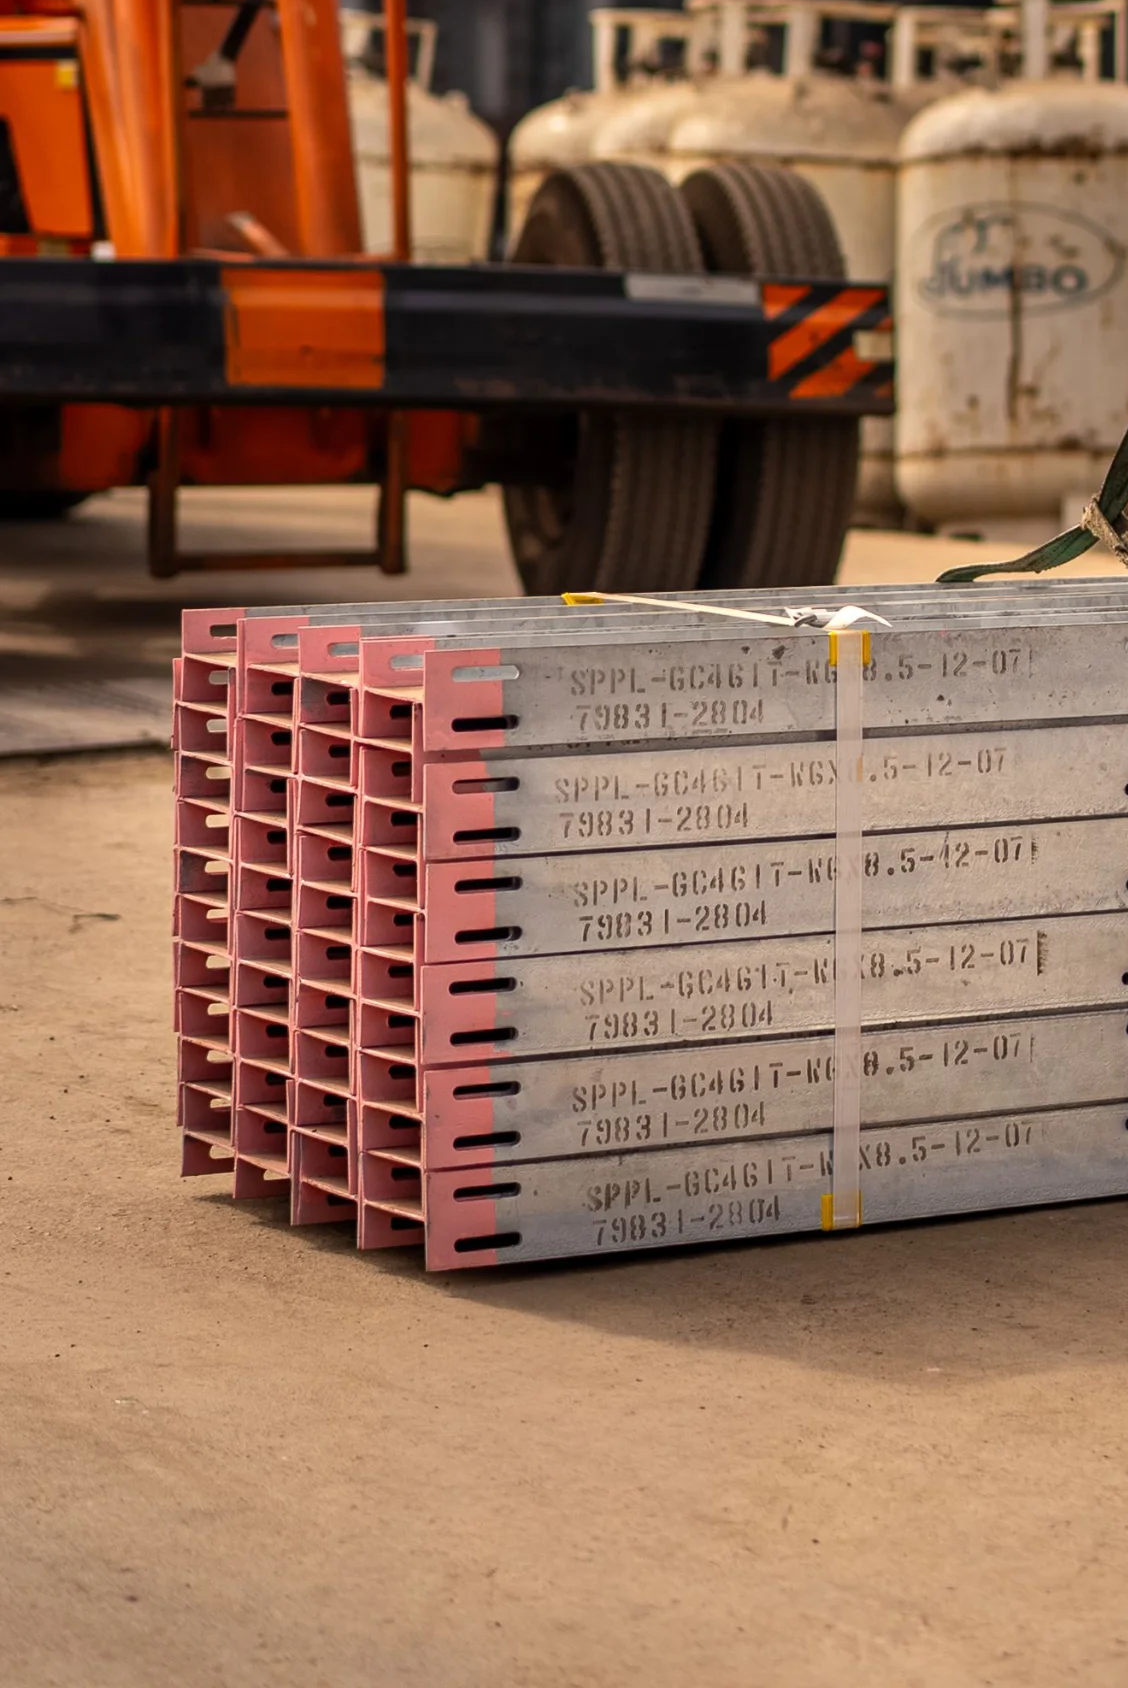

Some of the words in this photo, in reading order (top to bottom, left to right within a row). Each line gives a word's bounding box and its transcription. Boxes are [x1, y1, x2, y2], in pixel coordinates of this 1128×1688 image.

[576, 698, 764, 731] 79831-2804
[559, 802, 748, 839] 79831-2804
[579, 900, 767, 941] 79831-2804
[585, 1000, 773, 1041] 79831-2804
[577, 1101, 765, 1146] 79831-2804
[592, 1195, 781, 1246] 79831-2804
